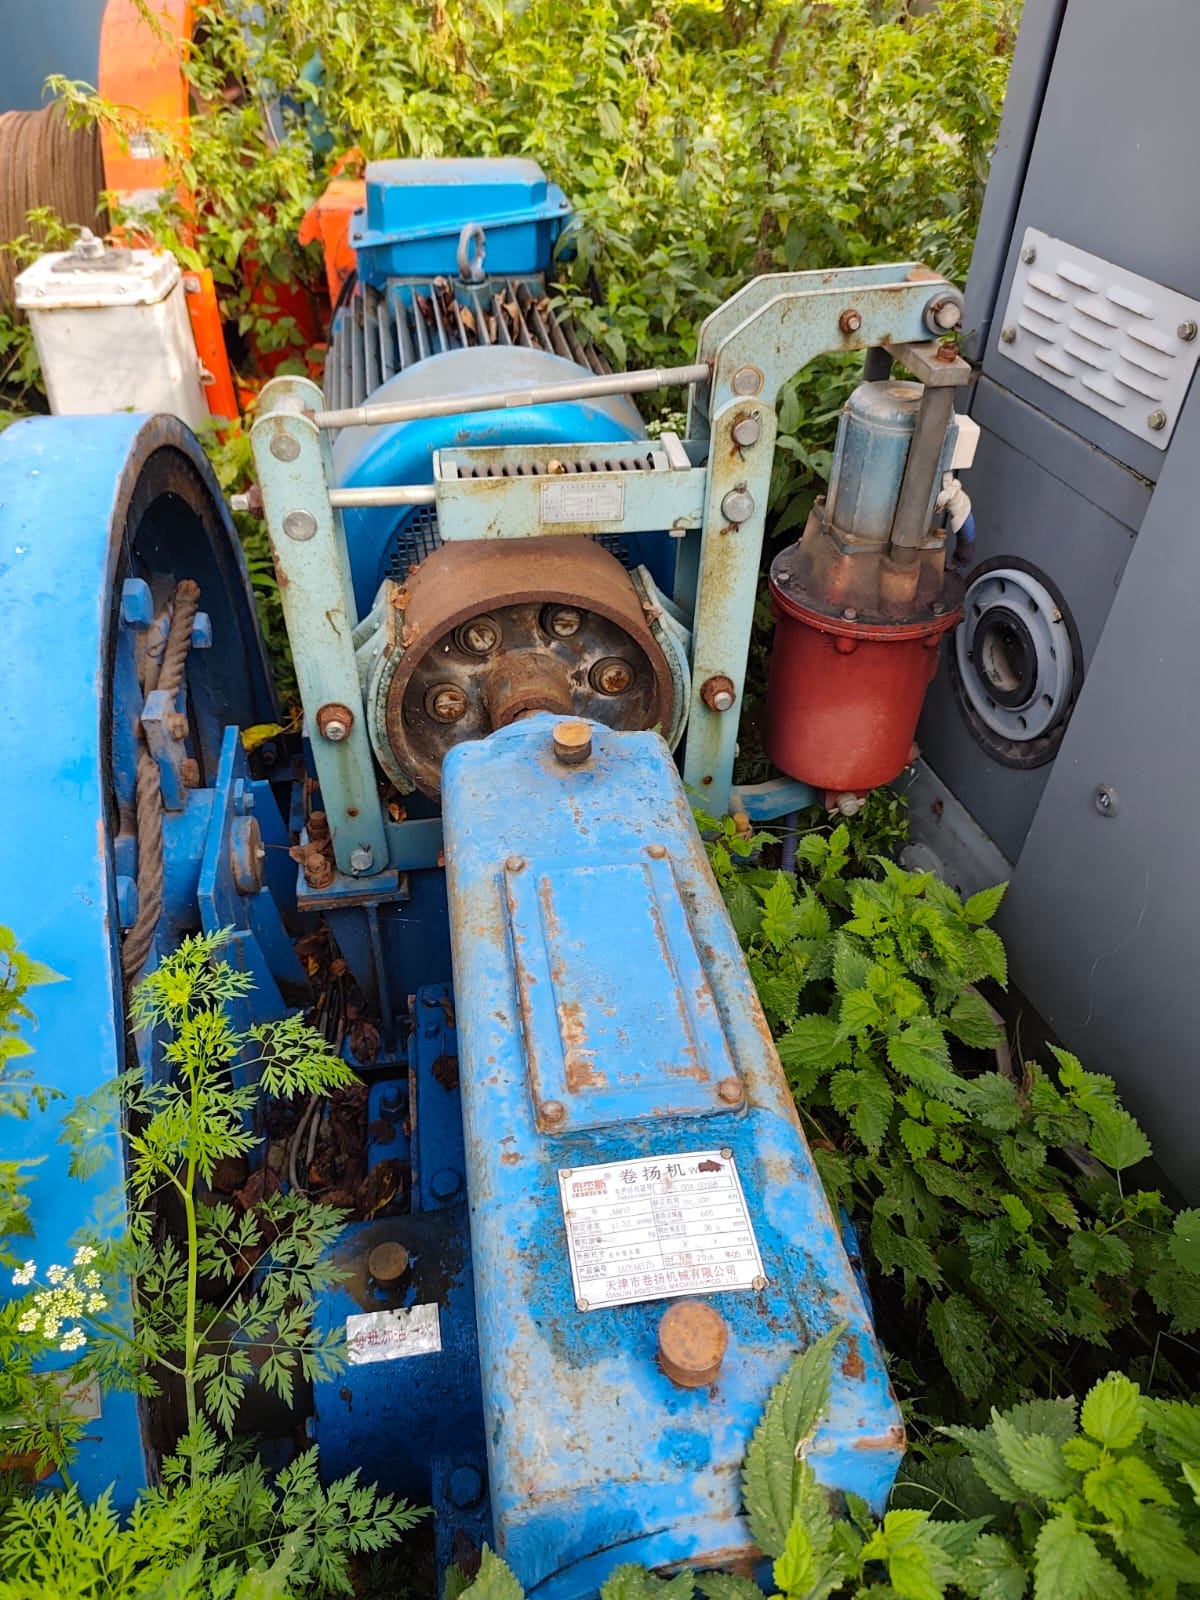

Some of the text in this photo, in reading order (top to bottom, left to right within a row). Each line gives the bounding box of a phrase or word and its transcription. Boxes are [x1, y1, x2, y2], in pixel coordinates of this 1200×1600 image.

[618, 1162, 686, 1184] 卷扬机
[605, 1262, 736, 1293] 天津市卷扬机械有限公司
